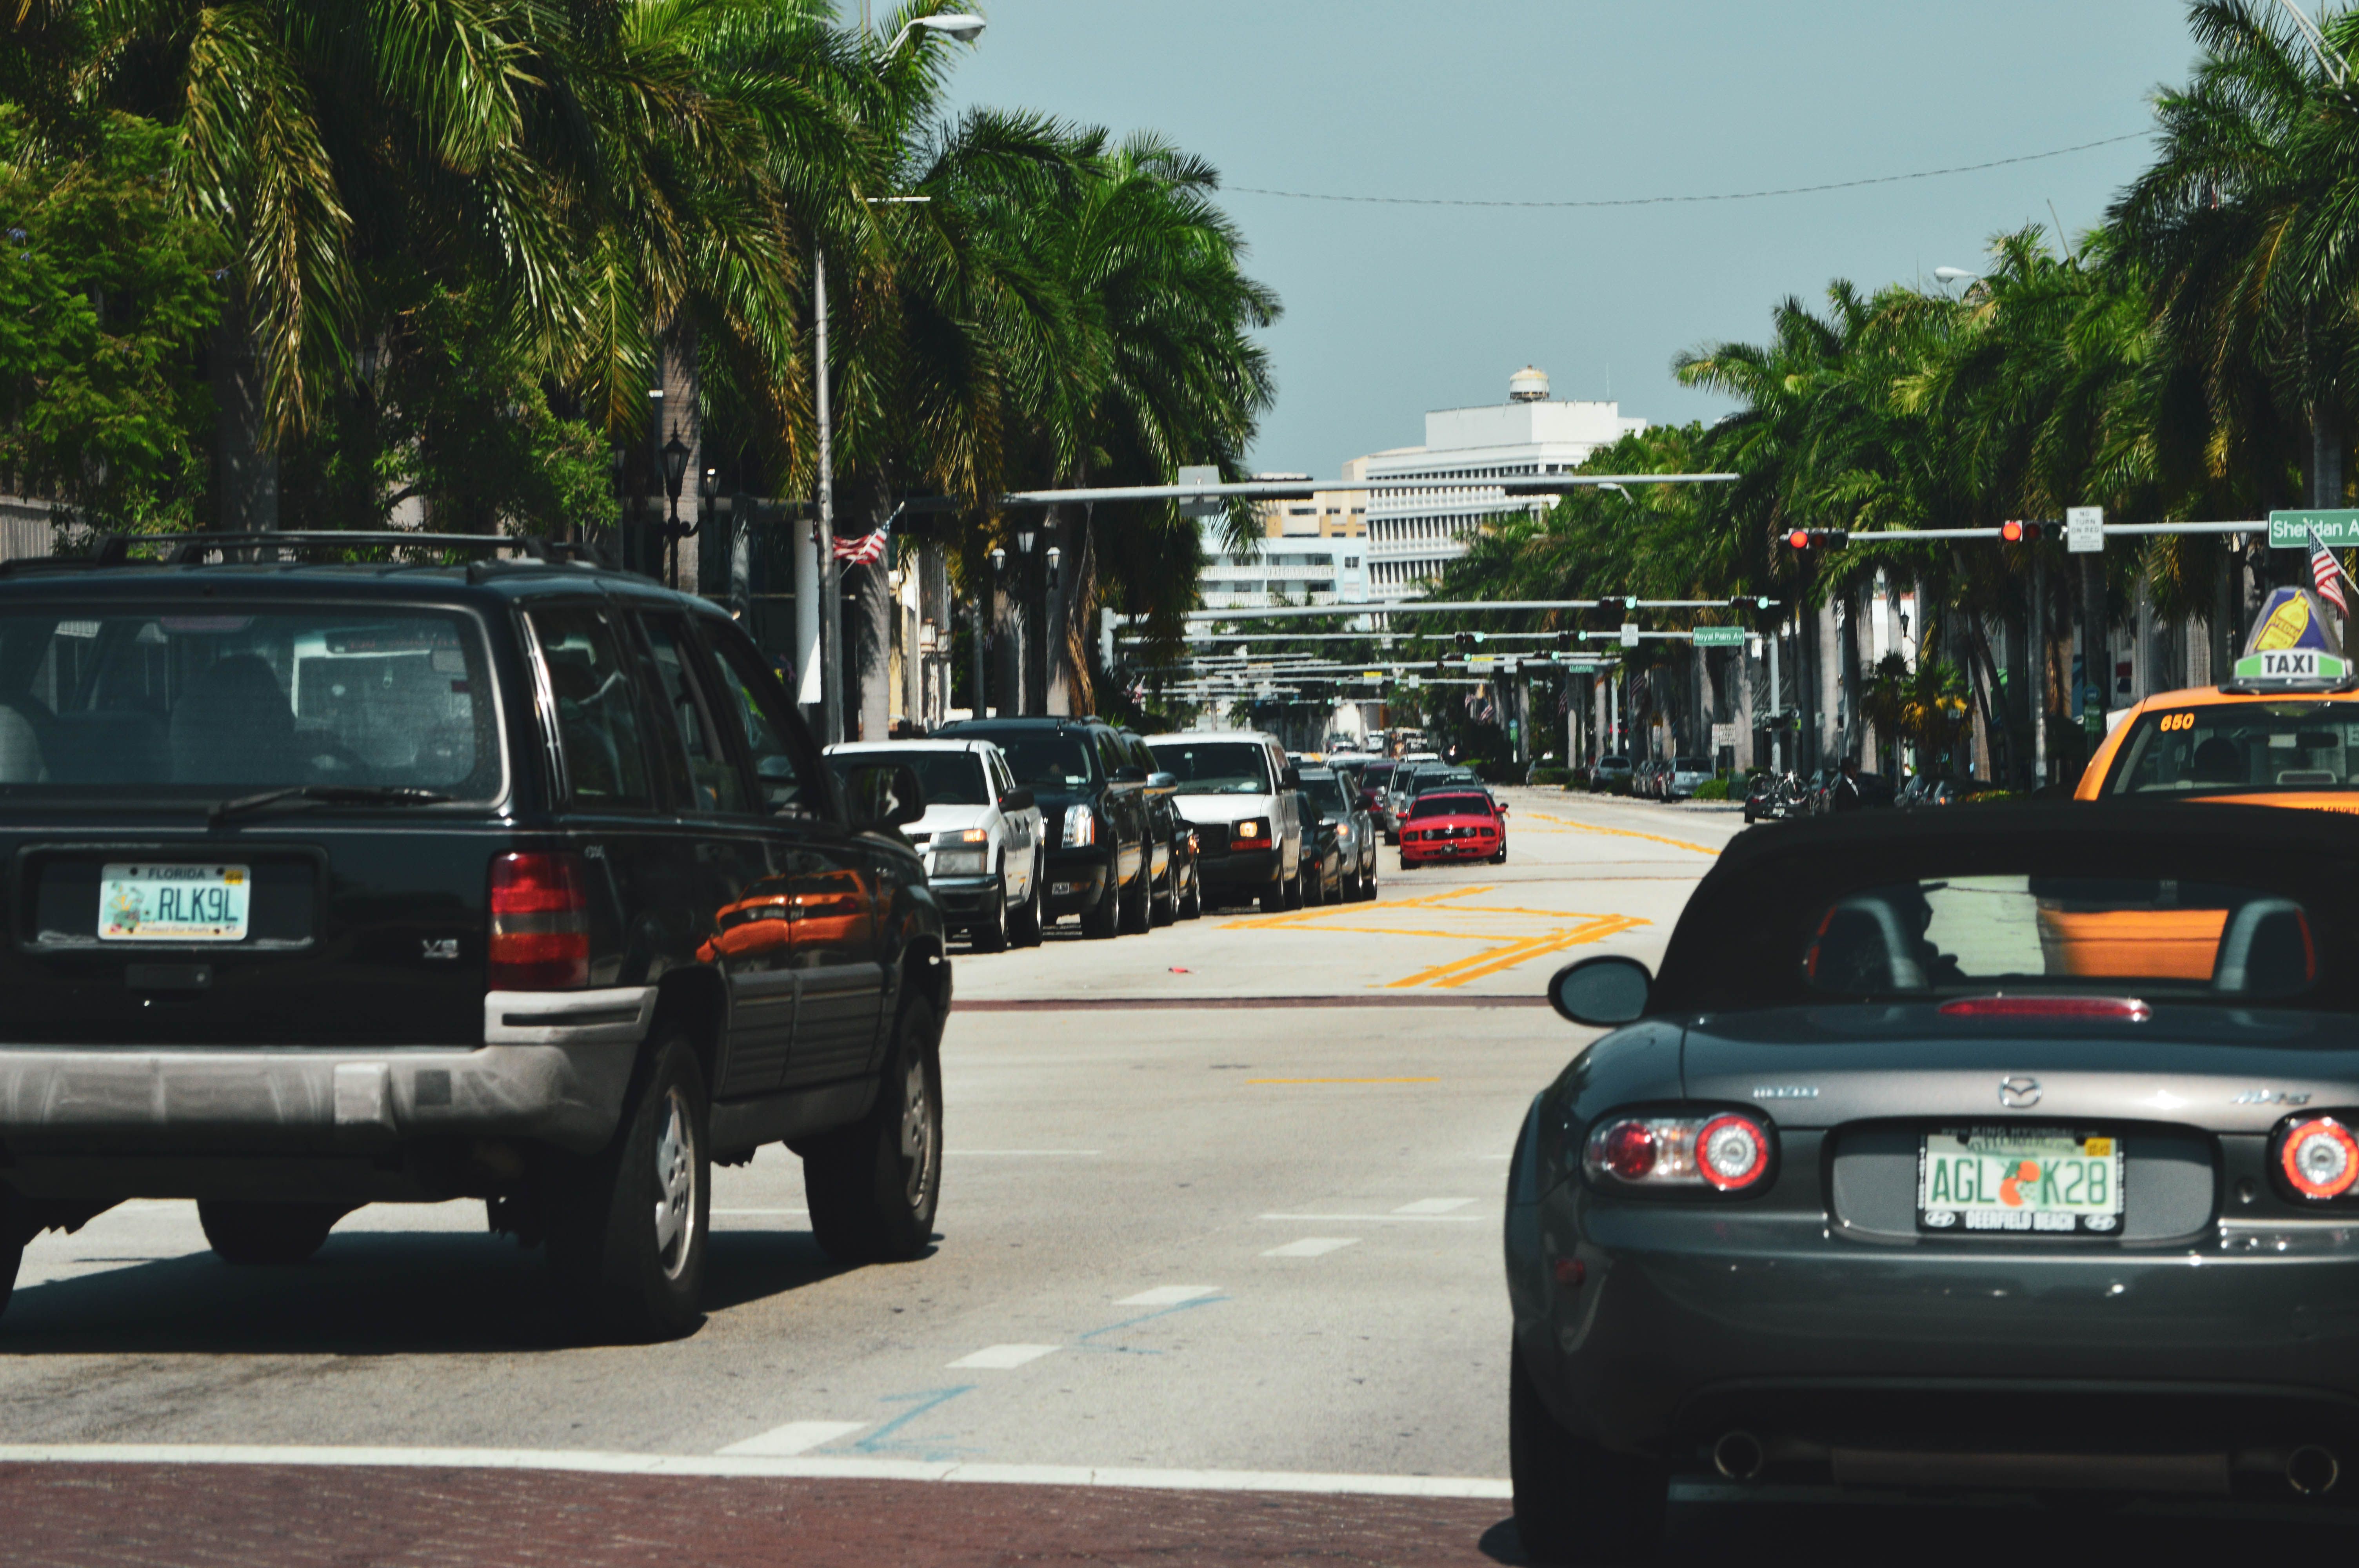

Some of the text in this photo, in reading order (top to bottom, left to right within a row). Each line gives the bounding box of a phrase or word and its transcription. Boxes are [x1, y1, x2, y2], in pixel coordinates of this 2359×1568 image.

[1695, 632, 1743, 642] Royal Palm Av
[2264, 655, 2313, 673] TAXI
[148, 867, 205, 879] FLORIDA
[158, 887, 238, 922] RLK9L
[1931, 1158, 1996, 1203] AGL
[2042, 1160, 2108, 1205] K28
[1965, 1211, 2075, 1230] DEERFIELD BEACH
